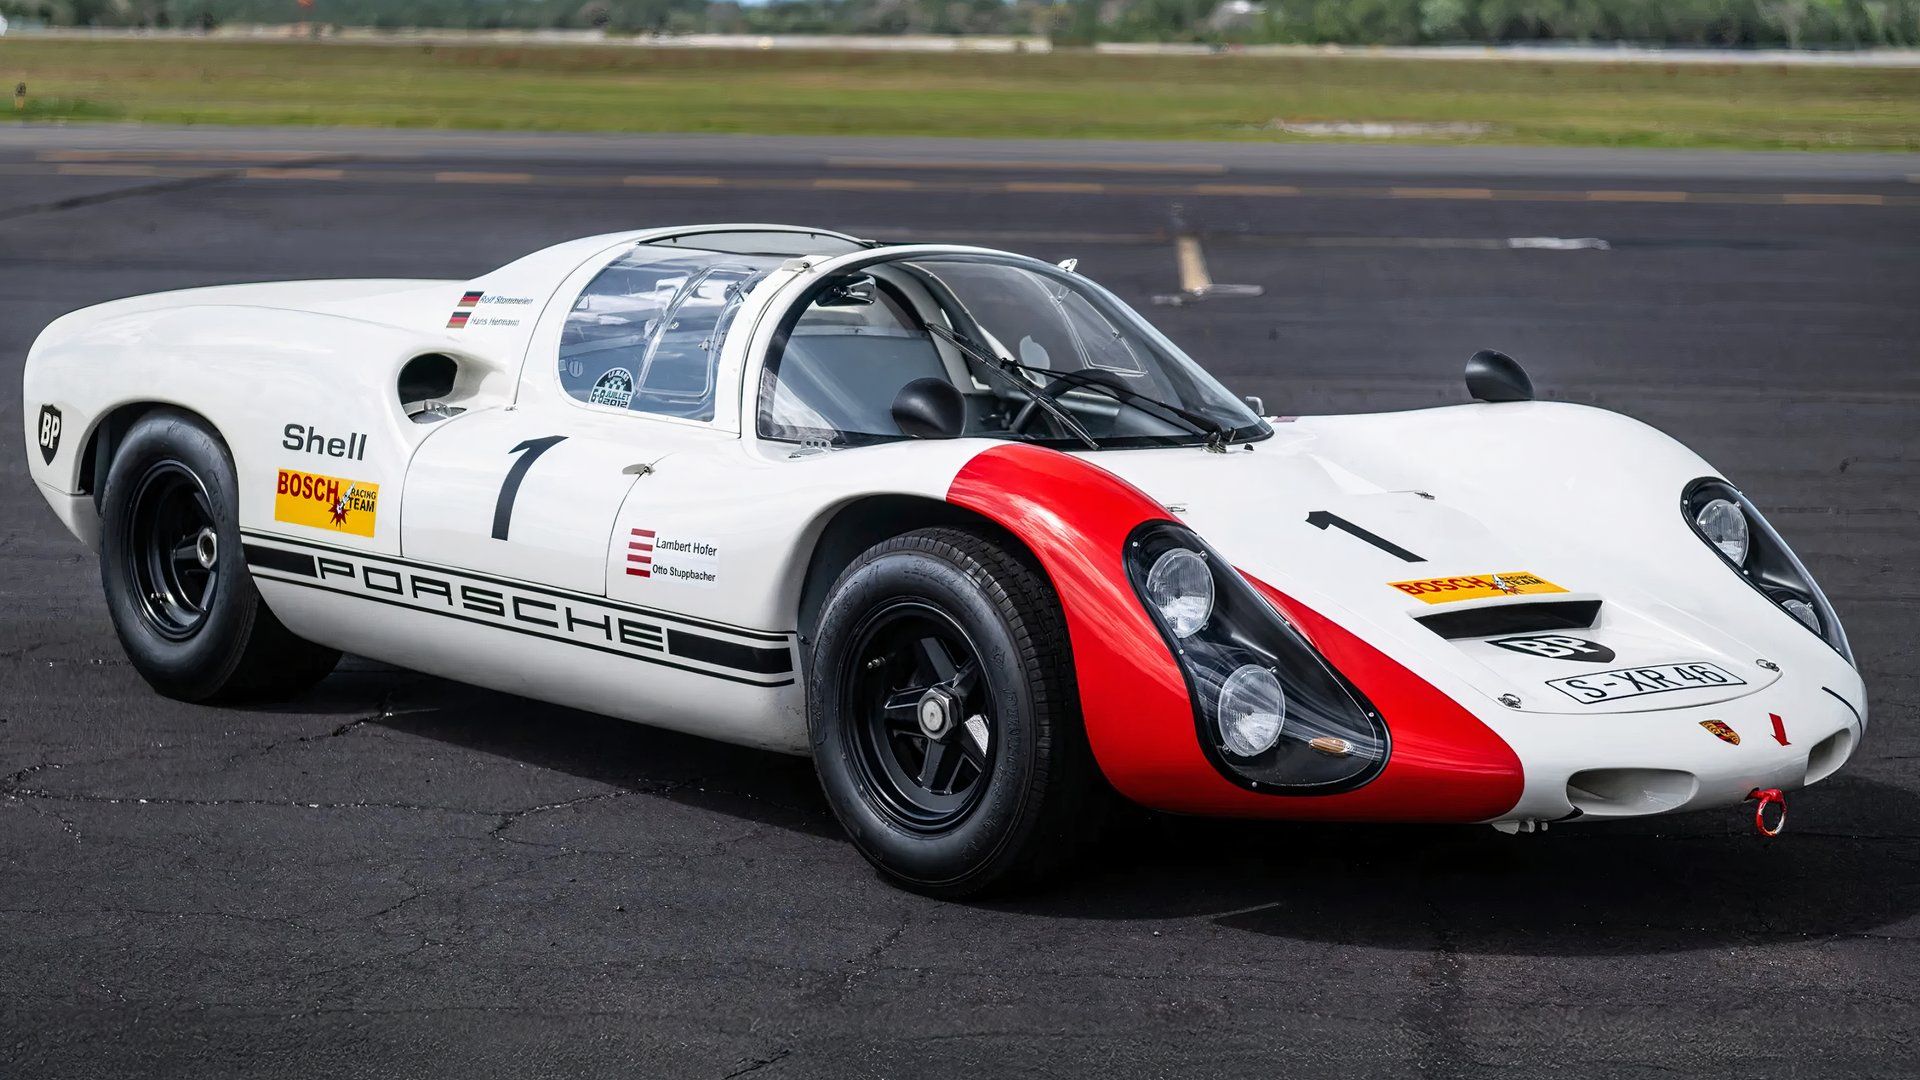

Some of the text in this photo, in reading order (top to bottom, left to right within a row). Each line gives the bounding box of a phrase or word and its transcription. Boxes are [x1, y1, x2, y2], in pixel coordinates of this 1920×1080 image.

[603, 399, 628, 408] 2012
[40, 411, 61, 450] BP
[282, 423, 368, 461] Shell
[277, 471, 340, 503] BOSCH
[350, 487, 377, 500] RACING
[491, 435, 570, 542] 1
[348, 498, 375, 513] TEAM
[656, 537, 717, 556] Lambert Hofer
[1304, 510, 1430, 563] 1
[652, 564, 716, 582] Otto Stuppbacher
[1393, 576, 1494, 596] BOSCH
[317, 556, 666, 653] PORSCHE
[1498, 637, 1602, 659] BP
[1679, 664, 1730, 685] 46
